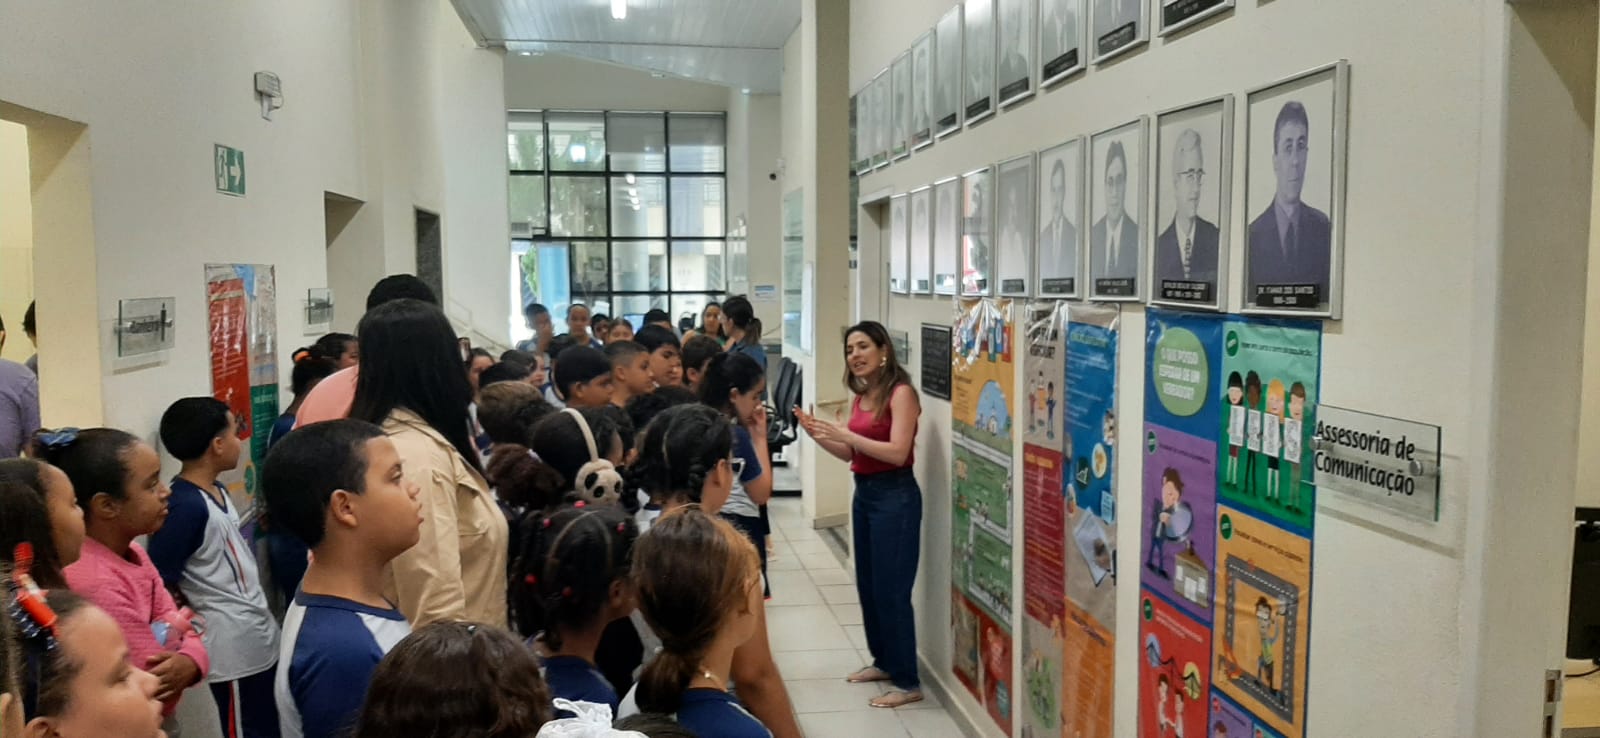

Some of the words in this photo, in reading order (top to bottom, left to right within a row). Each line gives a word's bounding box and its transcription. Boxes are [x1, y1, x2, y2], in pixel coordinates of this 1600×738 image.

[1317, 420, 1390, 455] Assessoria
[1395, 435, 1416, 461] de
[1315, 452, 1415, 496] Comunicação
